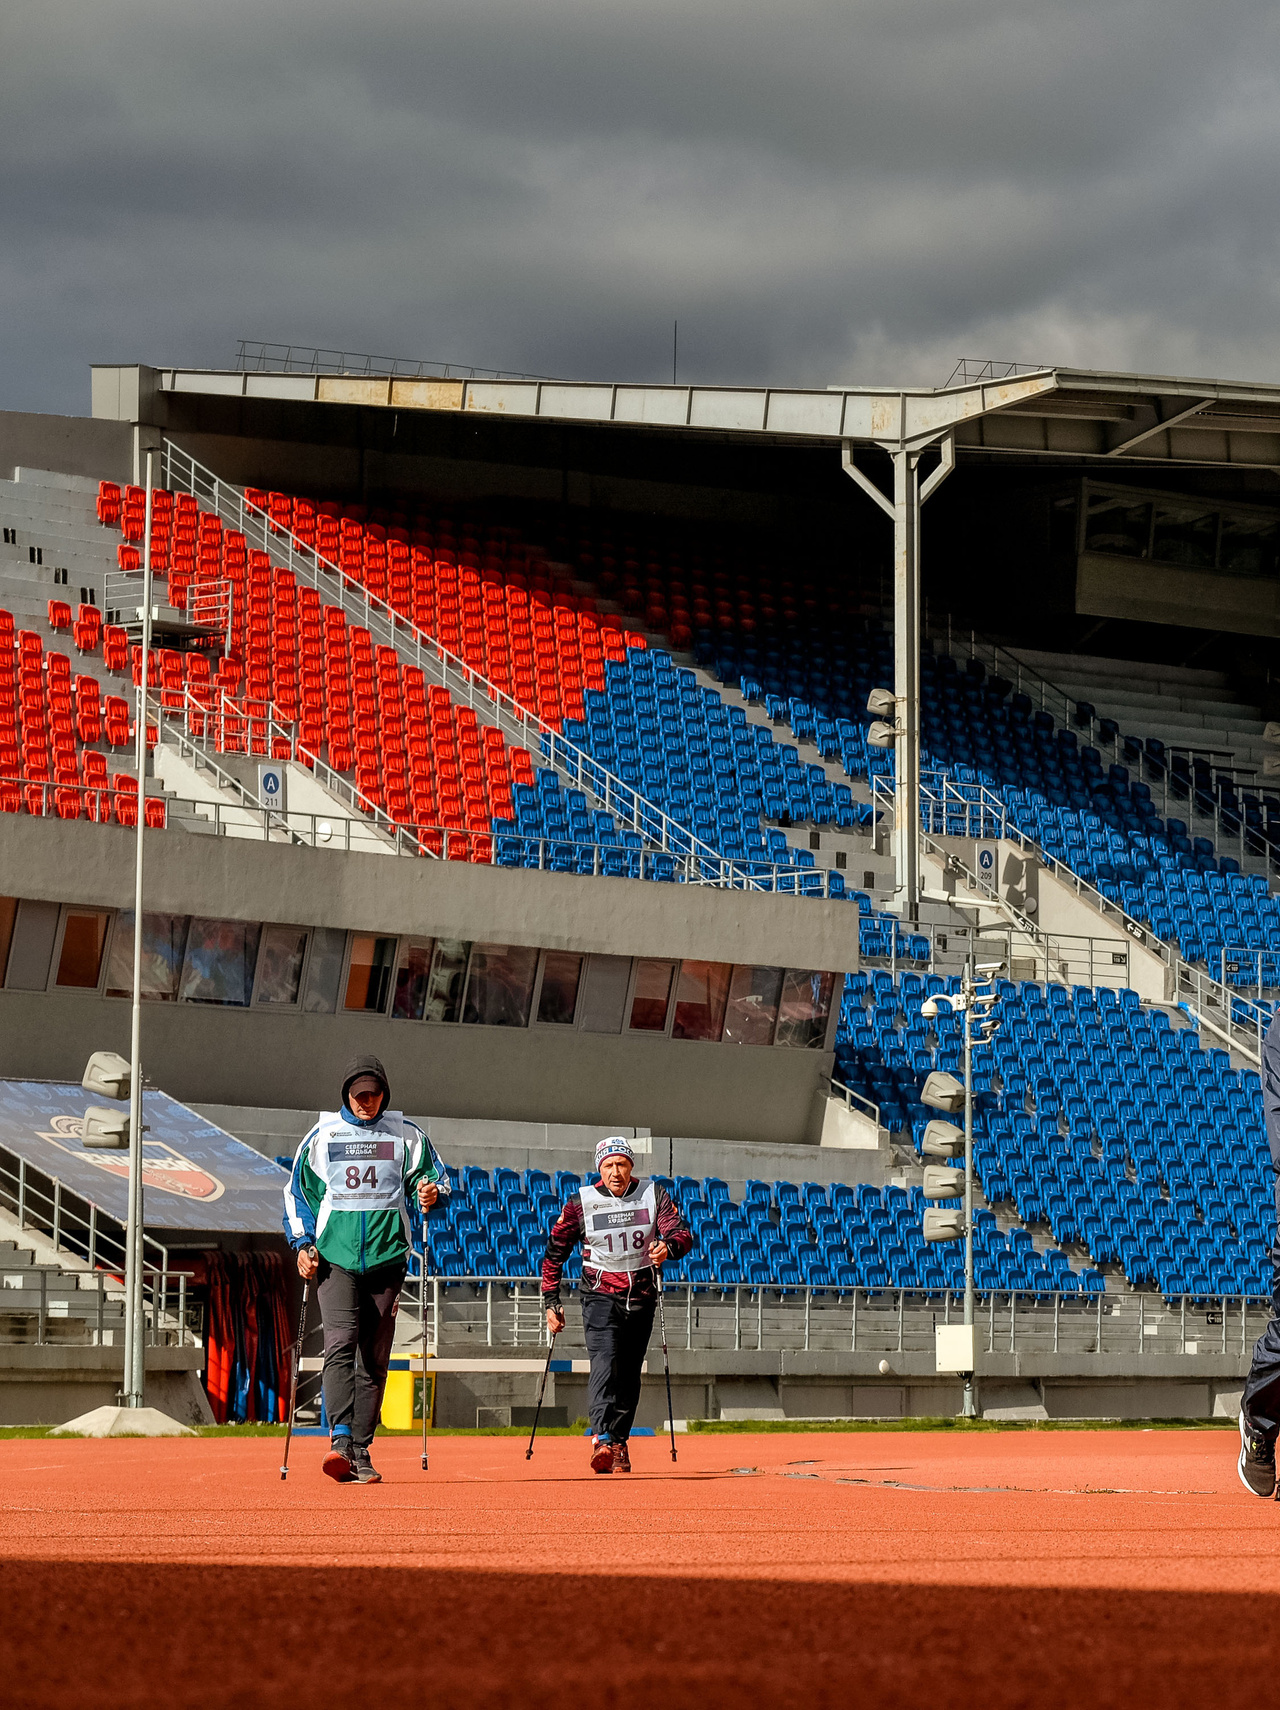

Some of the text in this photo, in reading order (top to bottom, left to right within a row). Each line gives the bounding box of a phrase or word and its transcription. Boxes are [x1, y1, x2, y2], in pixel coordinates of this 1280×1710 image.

[265, 797, 278, 806] 211
[980, 872, 992, 880] 209
[345, 1165, 379, 1190] 84
[607, 1212, 635, 1220] СЕВЕРНАЯ
[603, 1230, 645, 1253] 118
